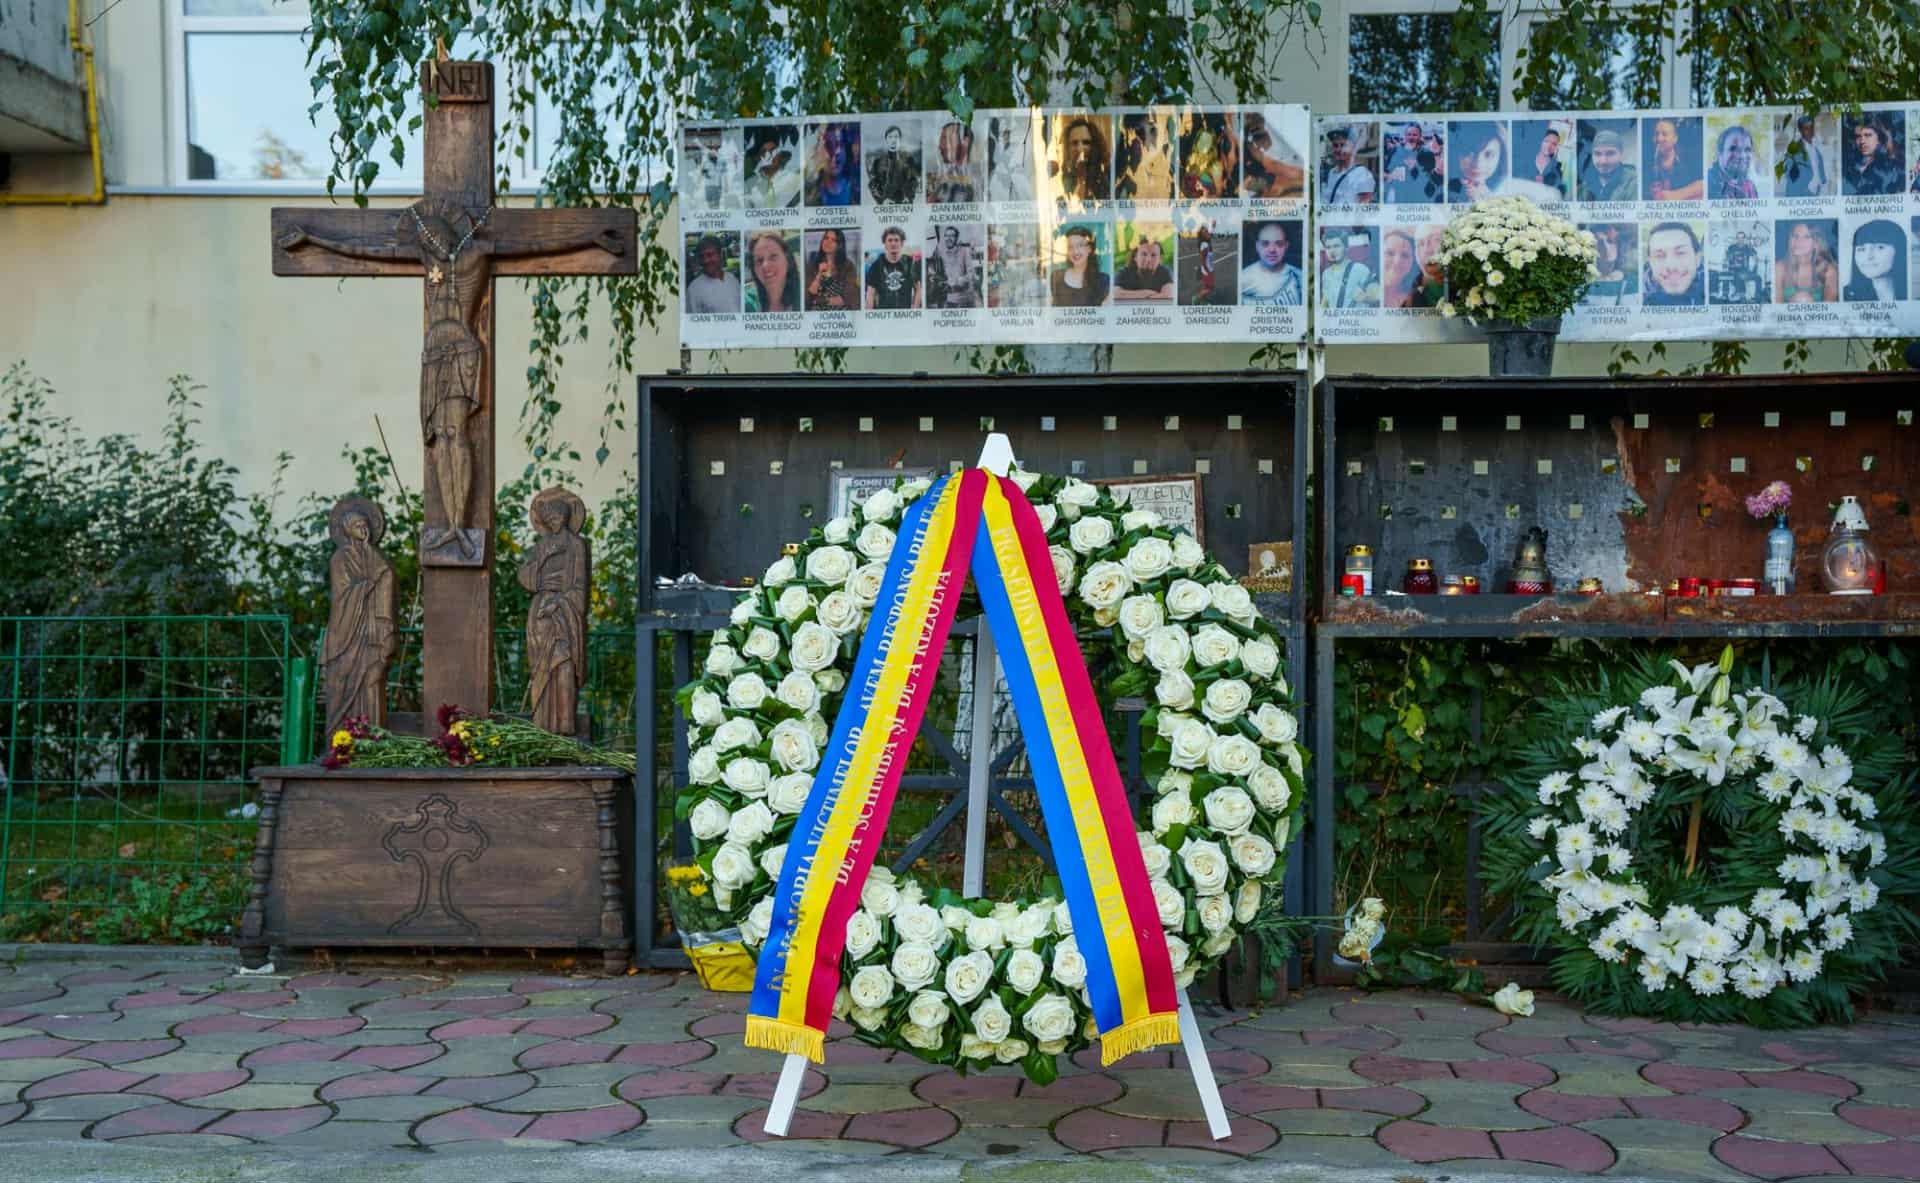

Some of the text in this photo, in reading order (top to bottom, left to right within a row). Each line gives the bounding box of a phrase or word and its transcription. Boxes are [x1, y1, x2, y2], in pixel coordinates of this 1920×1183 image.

[1845, 196, 1904, 205] ALEXANDRU
[745, 208, 799, 217] CONSTANTIN
[816, 207, 848, 216] COSTEL
[760, 218, 784, 226] IGNAT
[1132, 307, 1155, 315] LIVIU
[1183, 307, 1232, 315] LOREDANA
[1255, 306, 1288, 314] FLORIN
[1787, 304, 1829, 312] CARMEN
[813, 321, 853, 330] VICTORIA
[1250, 326, 1294, 334] POPESCU
[847, 742, 898, 831] SCHIMBA
[889, 679, 917, 708] DE
[906, 569, 953, 657] REZOLVA
[806, 726, 871, 845] VICTIMELOR
[858, 657, 894, 713] AVEM
